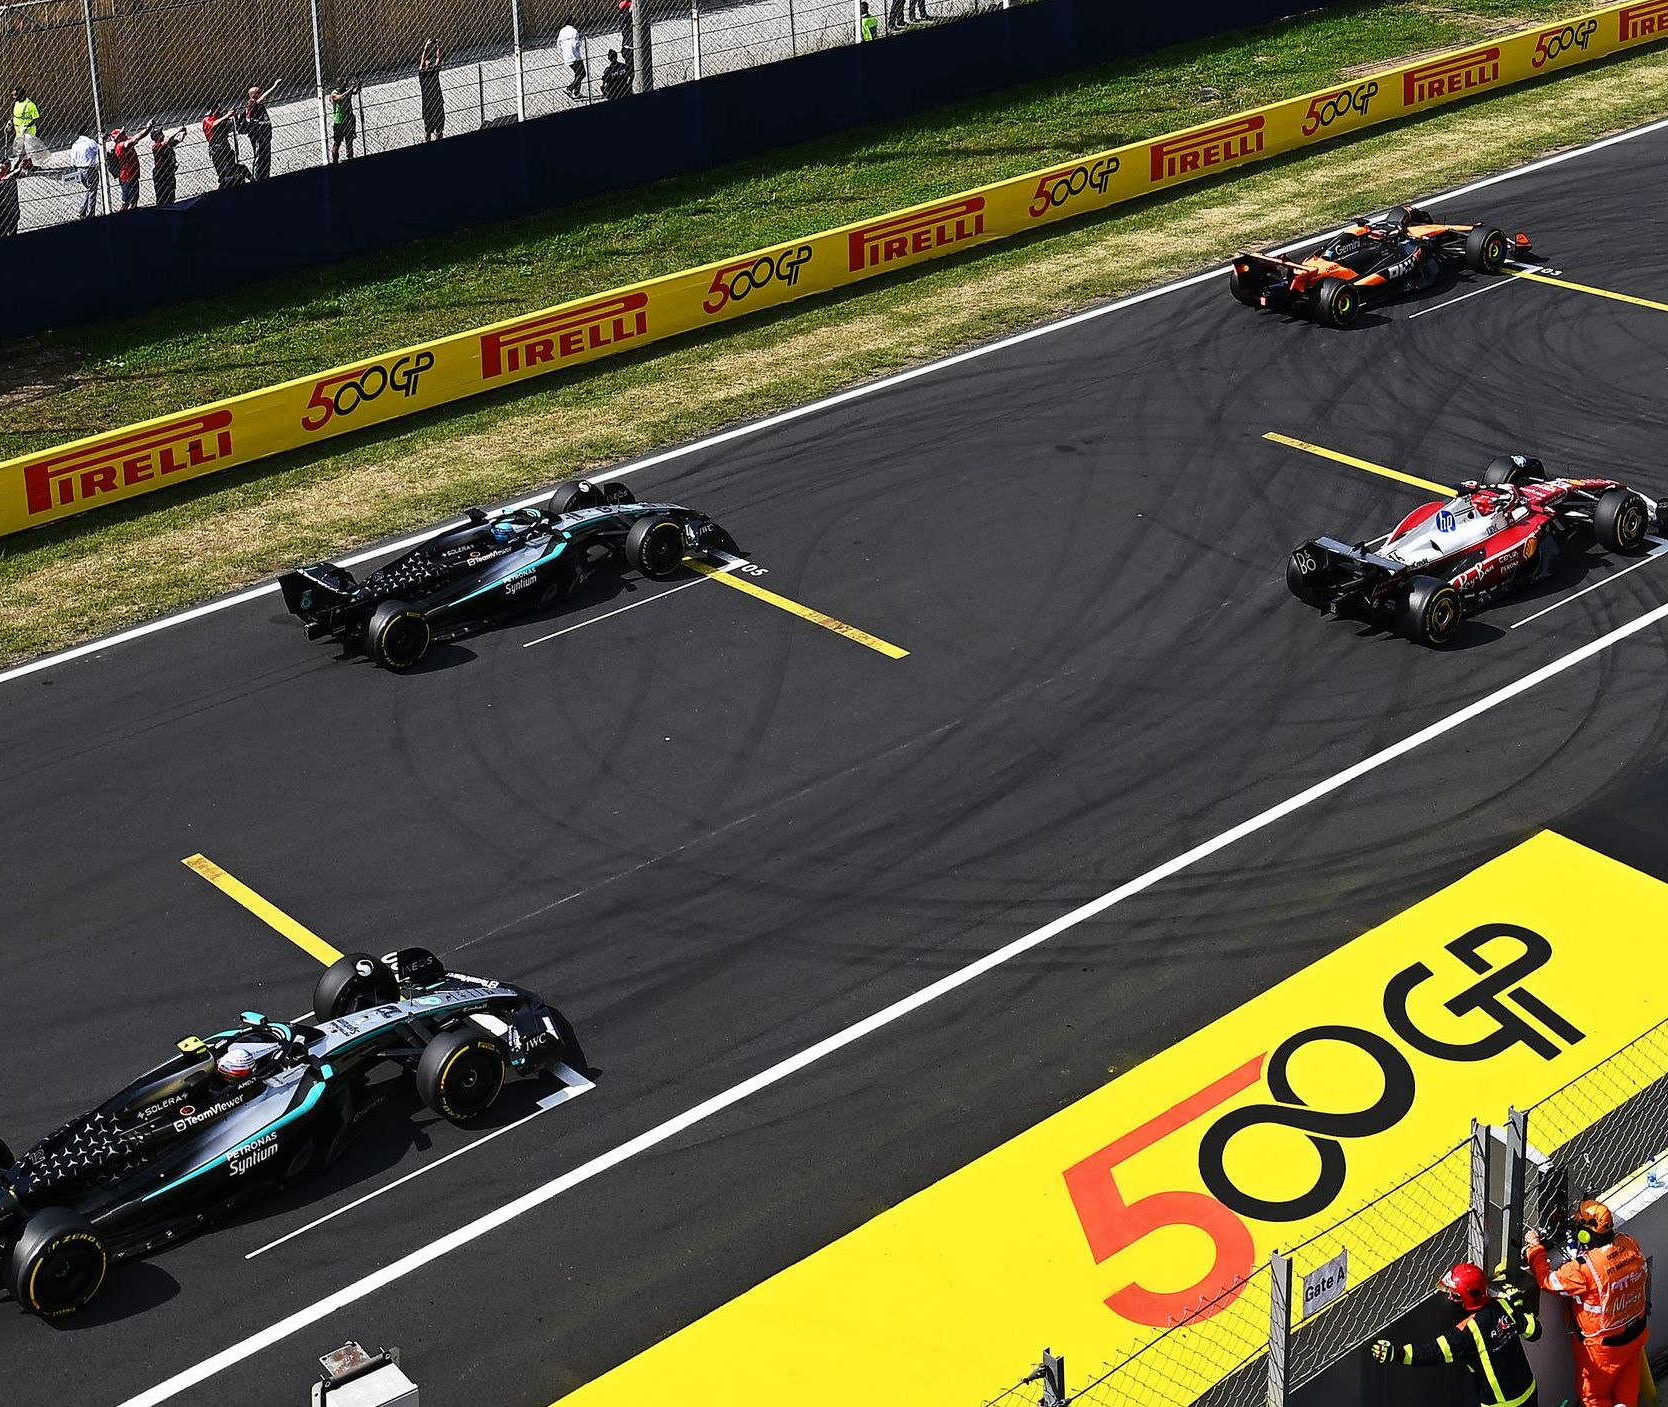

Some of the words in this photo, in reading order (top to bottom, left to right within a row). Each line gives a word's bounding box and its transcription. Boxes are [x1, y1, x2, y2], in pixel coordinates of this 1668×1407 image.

[1335, 237, 1361, 257] Gemini
[25, 410, 233, 514] PIRELLI
[481, 292, 648, 379] PIRELLI
[849, 197, 985, 271] PIRELLI
[1151, 115, 1264, 182] PIRELLI
[1404, 48, 1500, 106] PIRELLI
[1439, 511, 1454, 532] hp
[446, 545, 470, 557] SOLERA
[741, 564, 769, 577] 05
[402, 955, 433, 975] INEOS
[525, 1032, 547, 1052] IWC
[144, 1095, 182, 1117] SOLERA
[185, 1094, 244, 1126] TeamViewer
[29, 1148, 46, 1165] 12
[226, 1131, 277, 1162] PETRONAS
[229, 1143, 279, 1177] Syntium
[61, 1232, 97, 1244] ZERO
[1305, 1275, 1335, 1303] Gate
[1336, 1270, 1346, 1284] A
